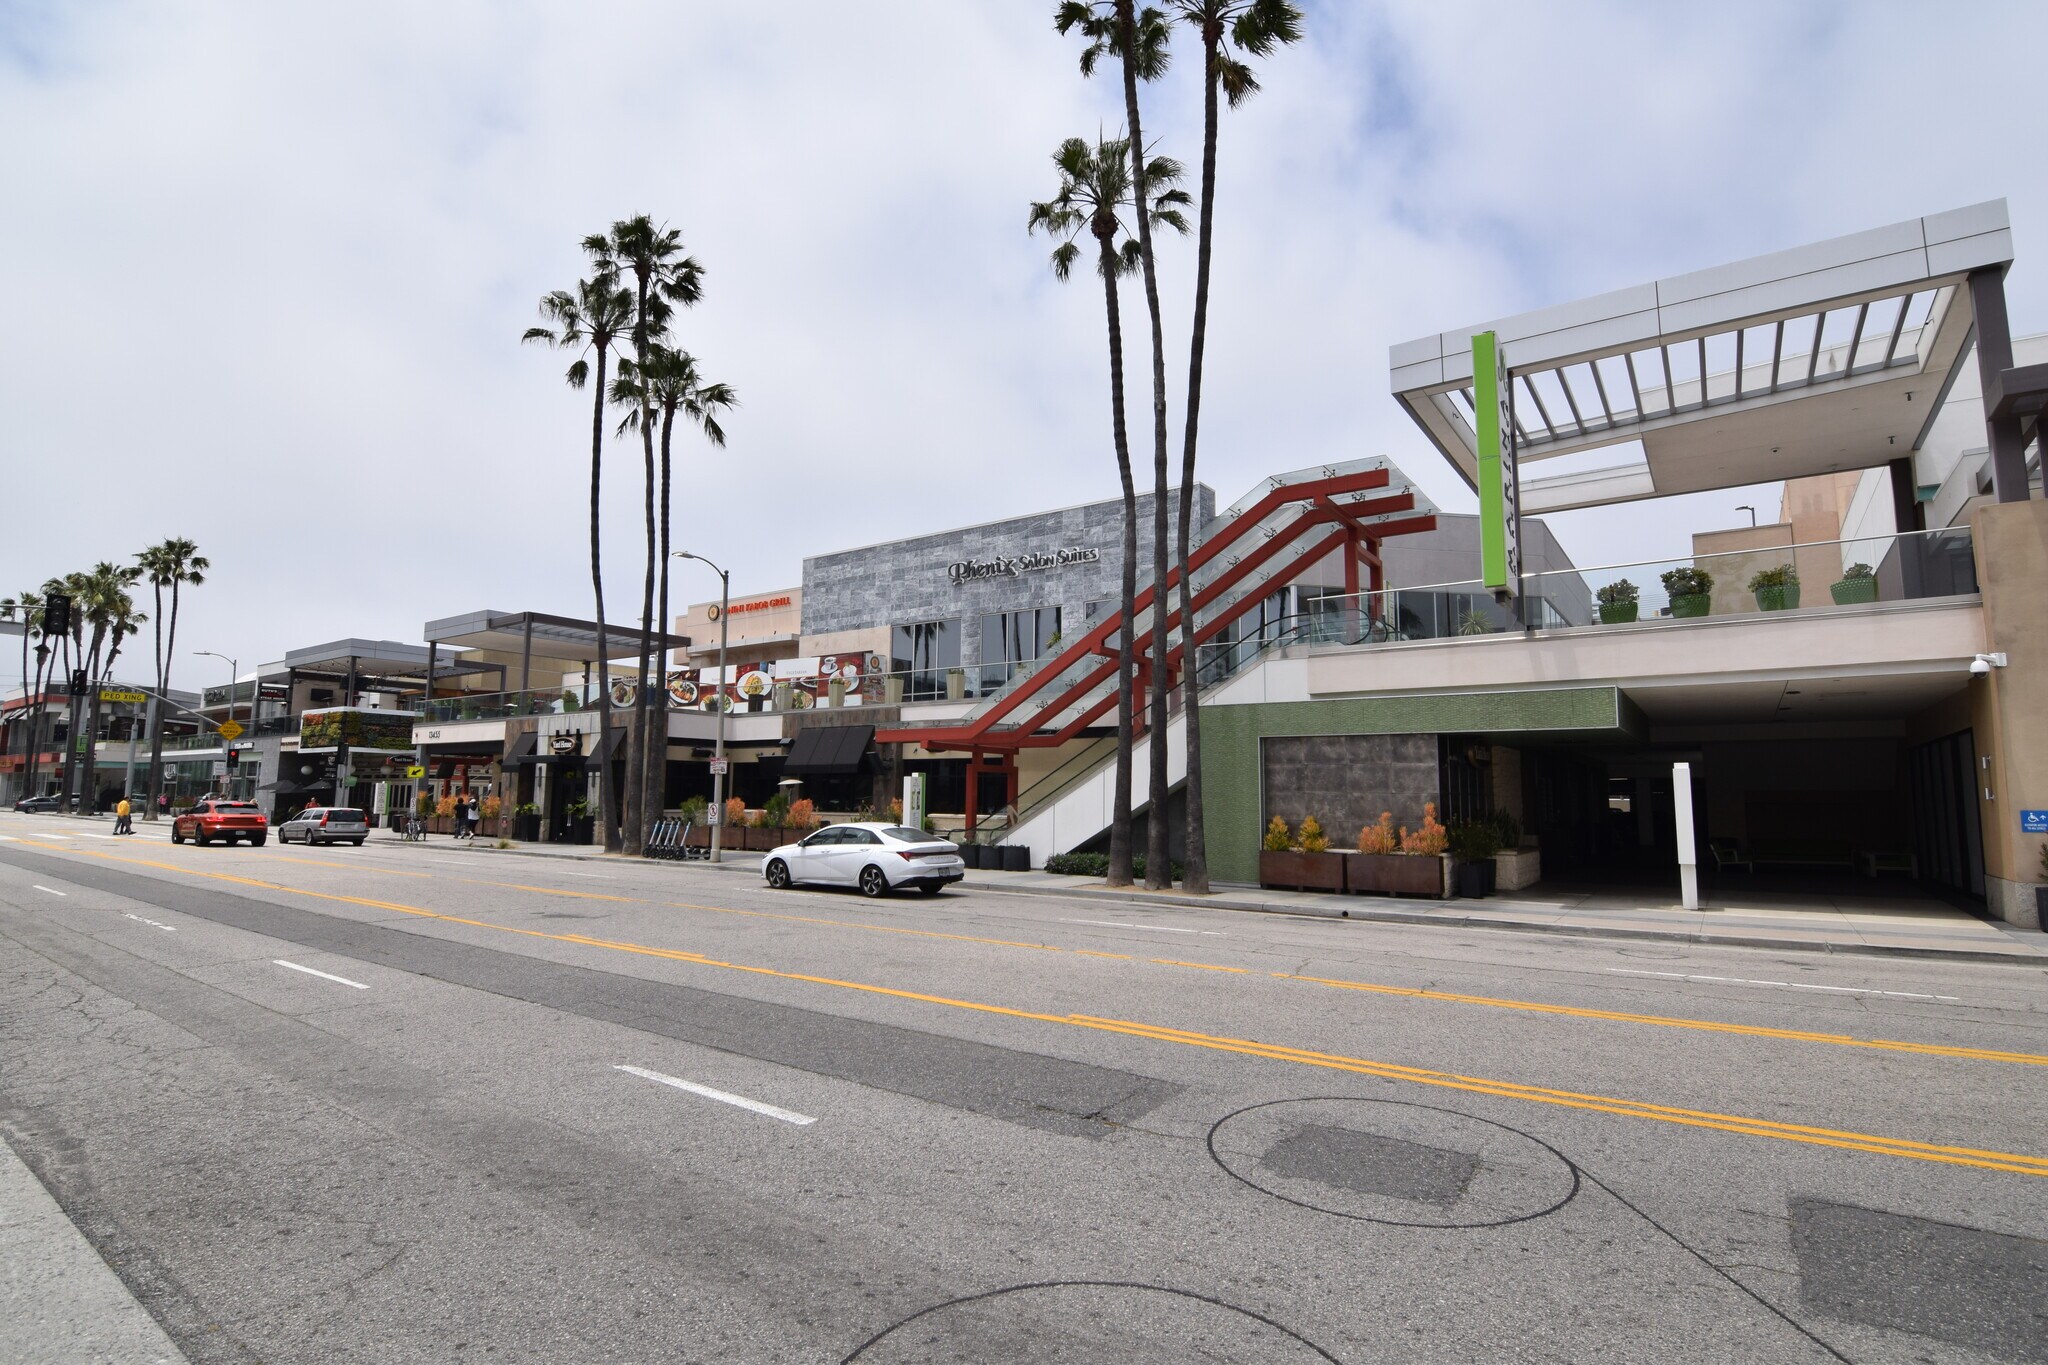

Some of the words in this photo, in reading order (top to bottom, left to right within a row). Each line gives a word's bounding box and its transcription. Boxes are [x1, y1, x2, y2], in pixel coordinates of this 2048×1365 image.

[1500, 400, 1514, 573] MARINA
[948, 556, 1018, 585] Phenix
[745, 600, 769, 612] KABOB
[769, 596, 791, 608] GRILL
[104, 692, 121, 700] PED
[123, 693, 142, 701] XING
